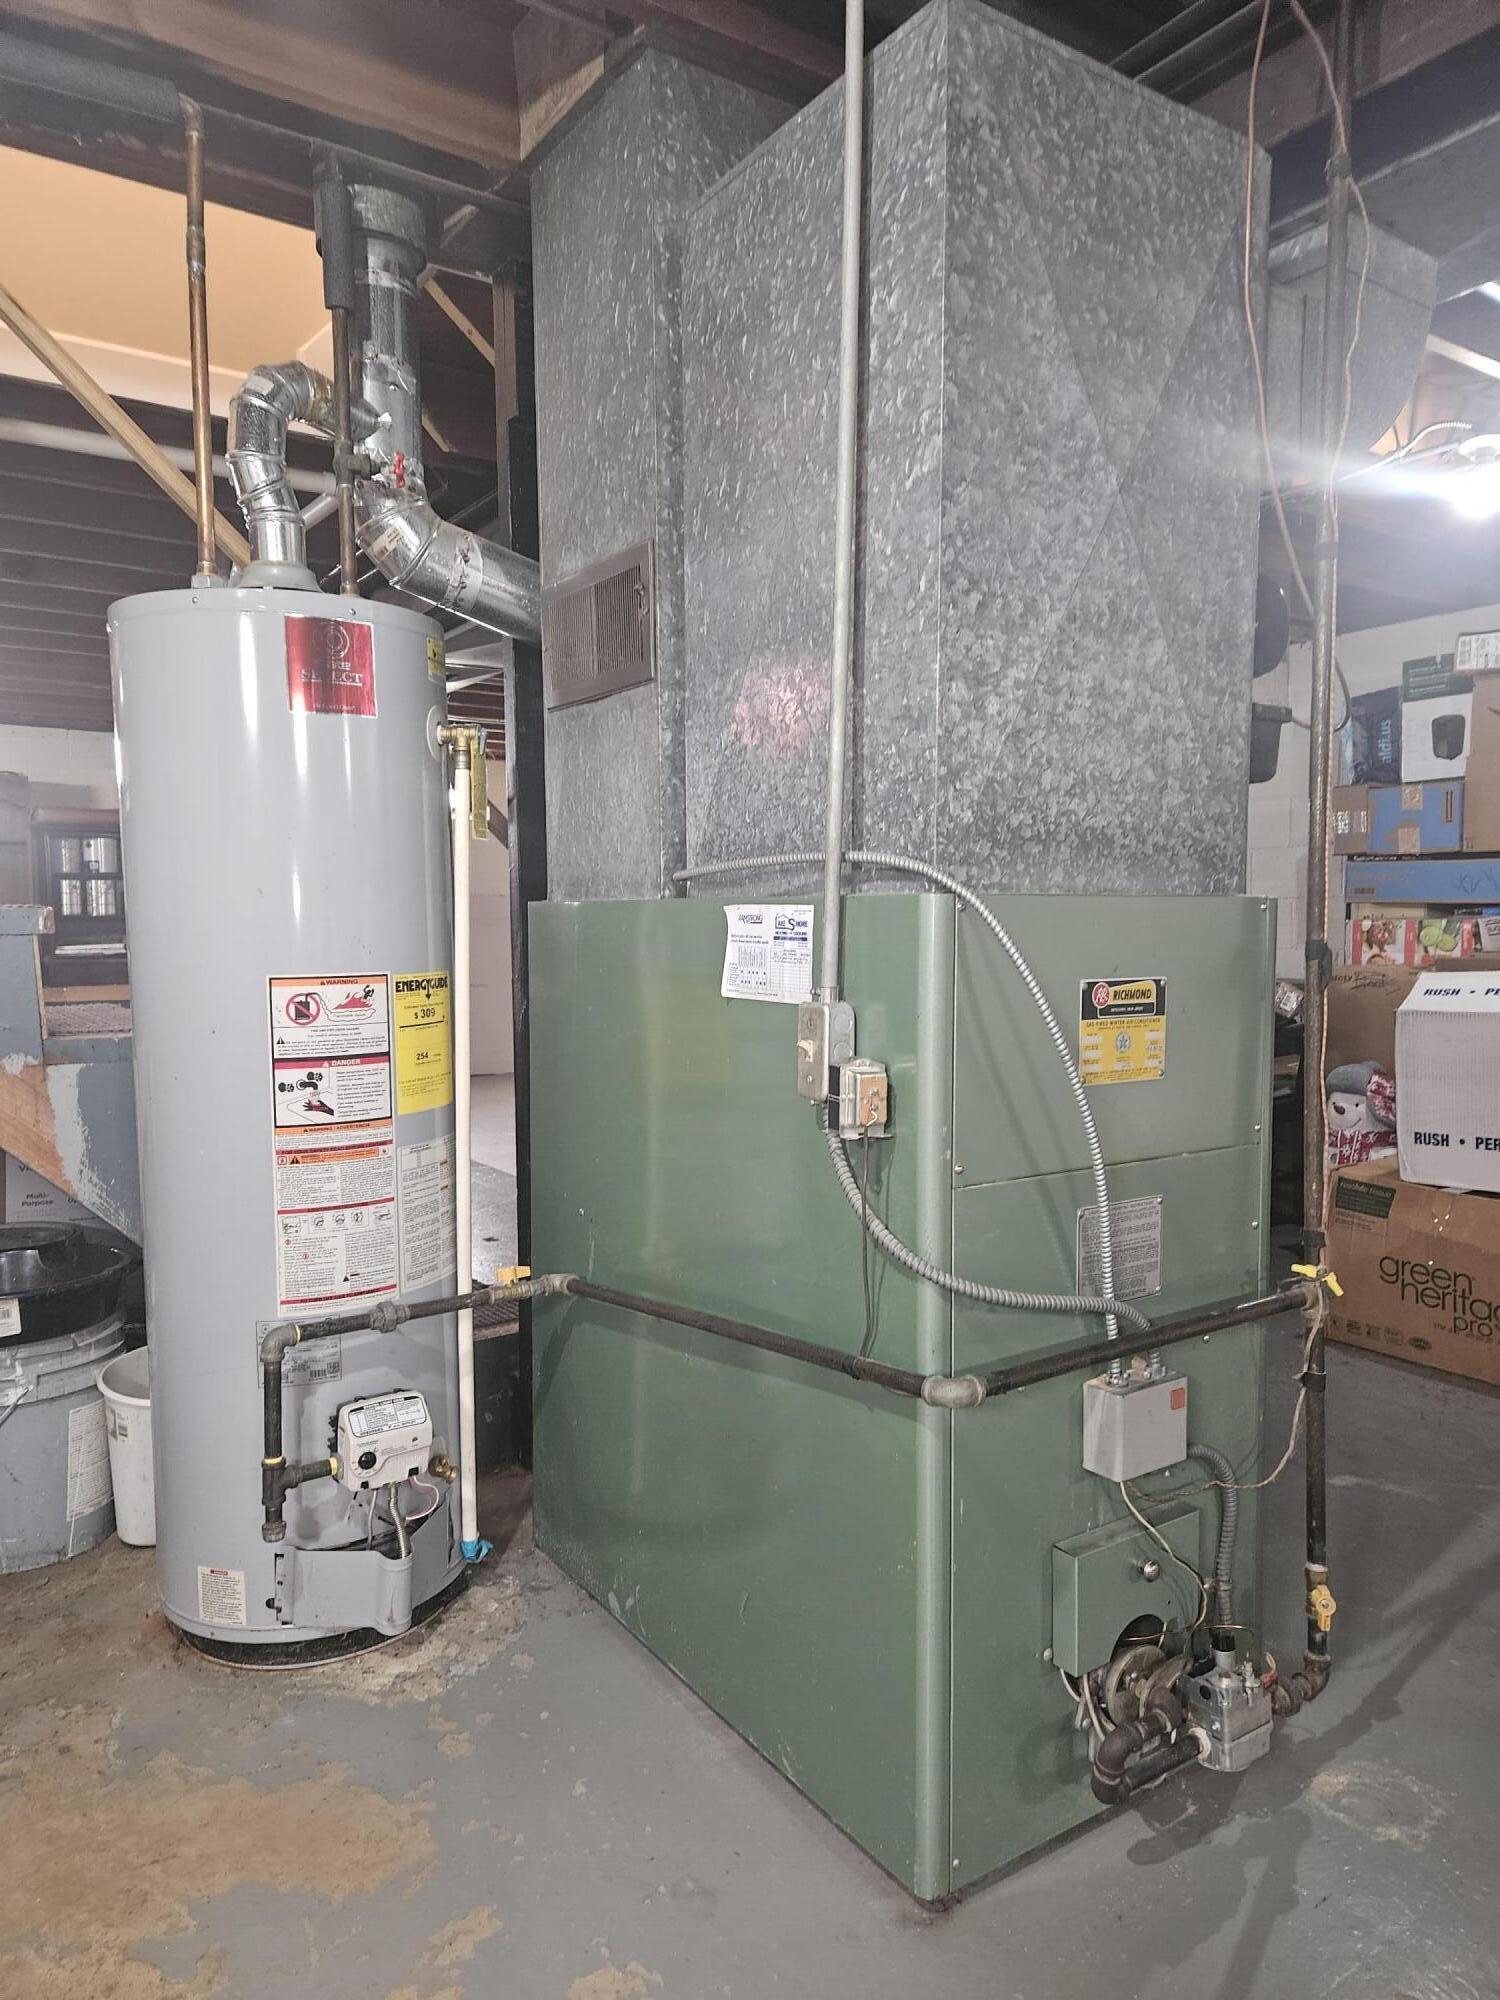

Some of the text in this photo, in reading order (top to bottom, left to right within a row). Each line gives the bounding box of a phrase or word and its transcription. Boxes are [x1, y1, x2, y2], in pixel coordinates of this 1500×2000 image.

[395, 976, 449, 992] ENERGYGUIDE
[1113, 989, 1152, 1001] RICHMOND
[1424, 988, 1461, 996] RUSH
[421, 1008, 436, 1019] 309
[416, 1052, 429, 1061] 254
[331, 1059, 361, 1067] DANGER
[1414, 1131, 1449, 1147] RUSH
[1380, 1256, 1472, 1296] green
[1454, 1316, 1493, 1337] pro
